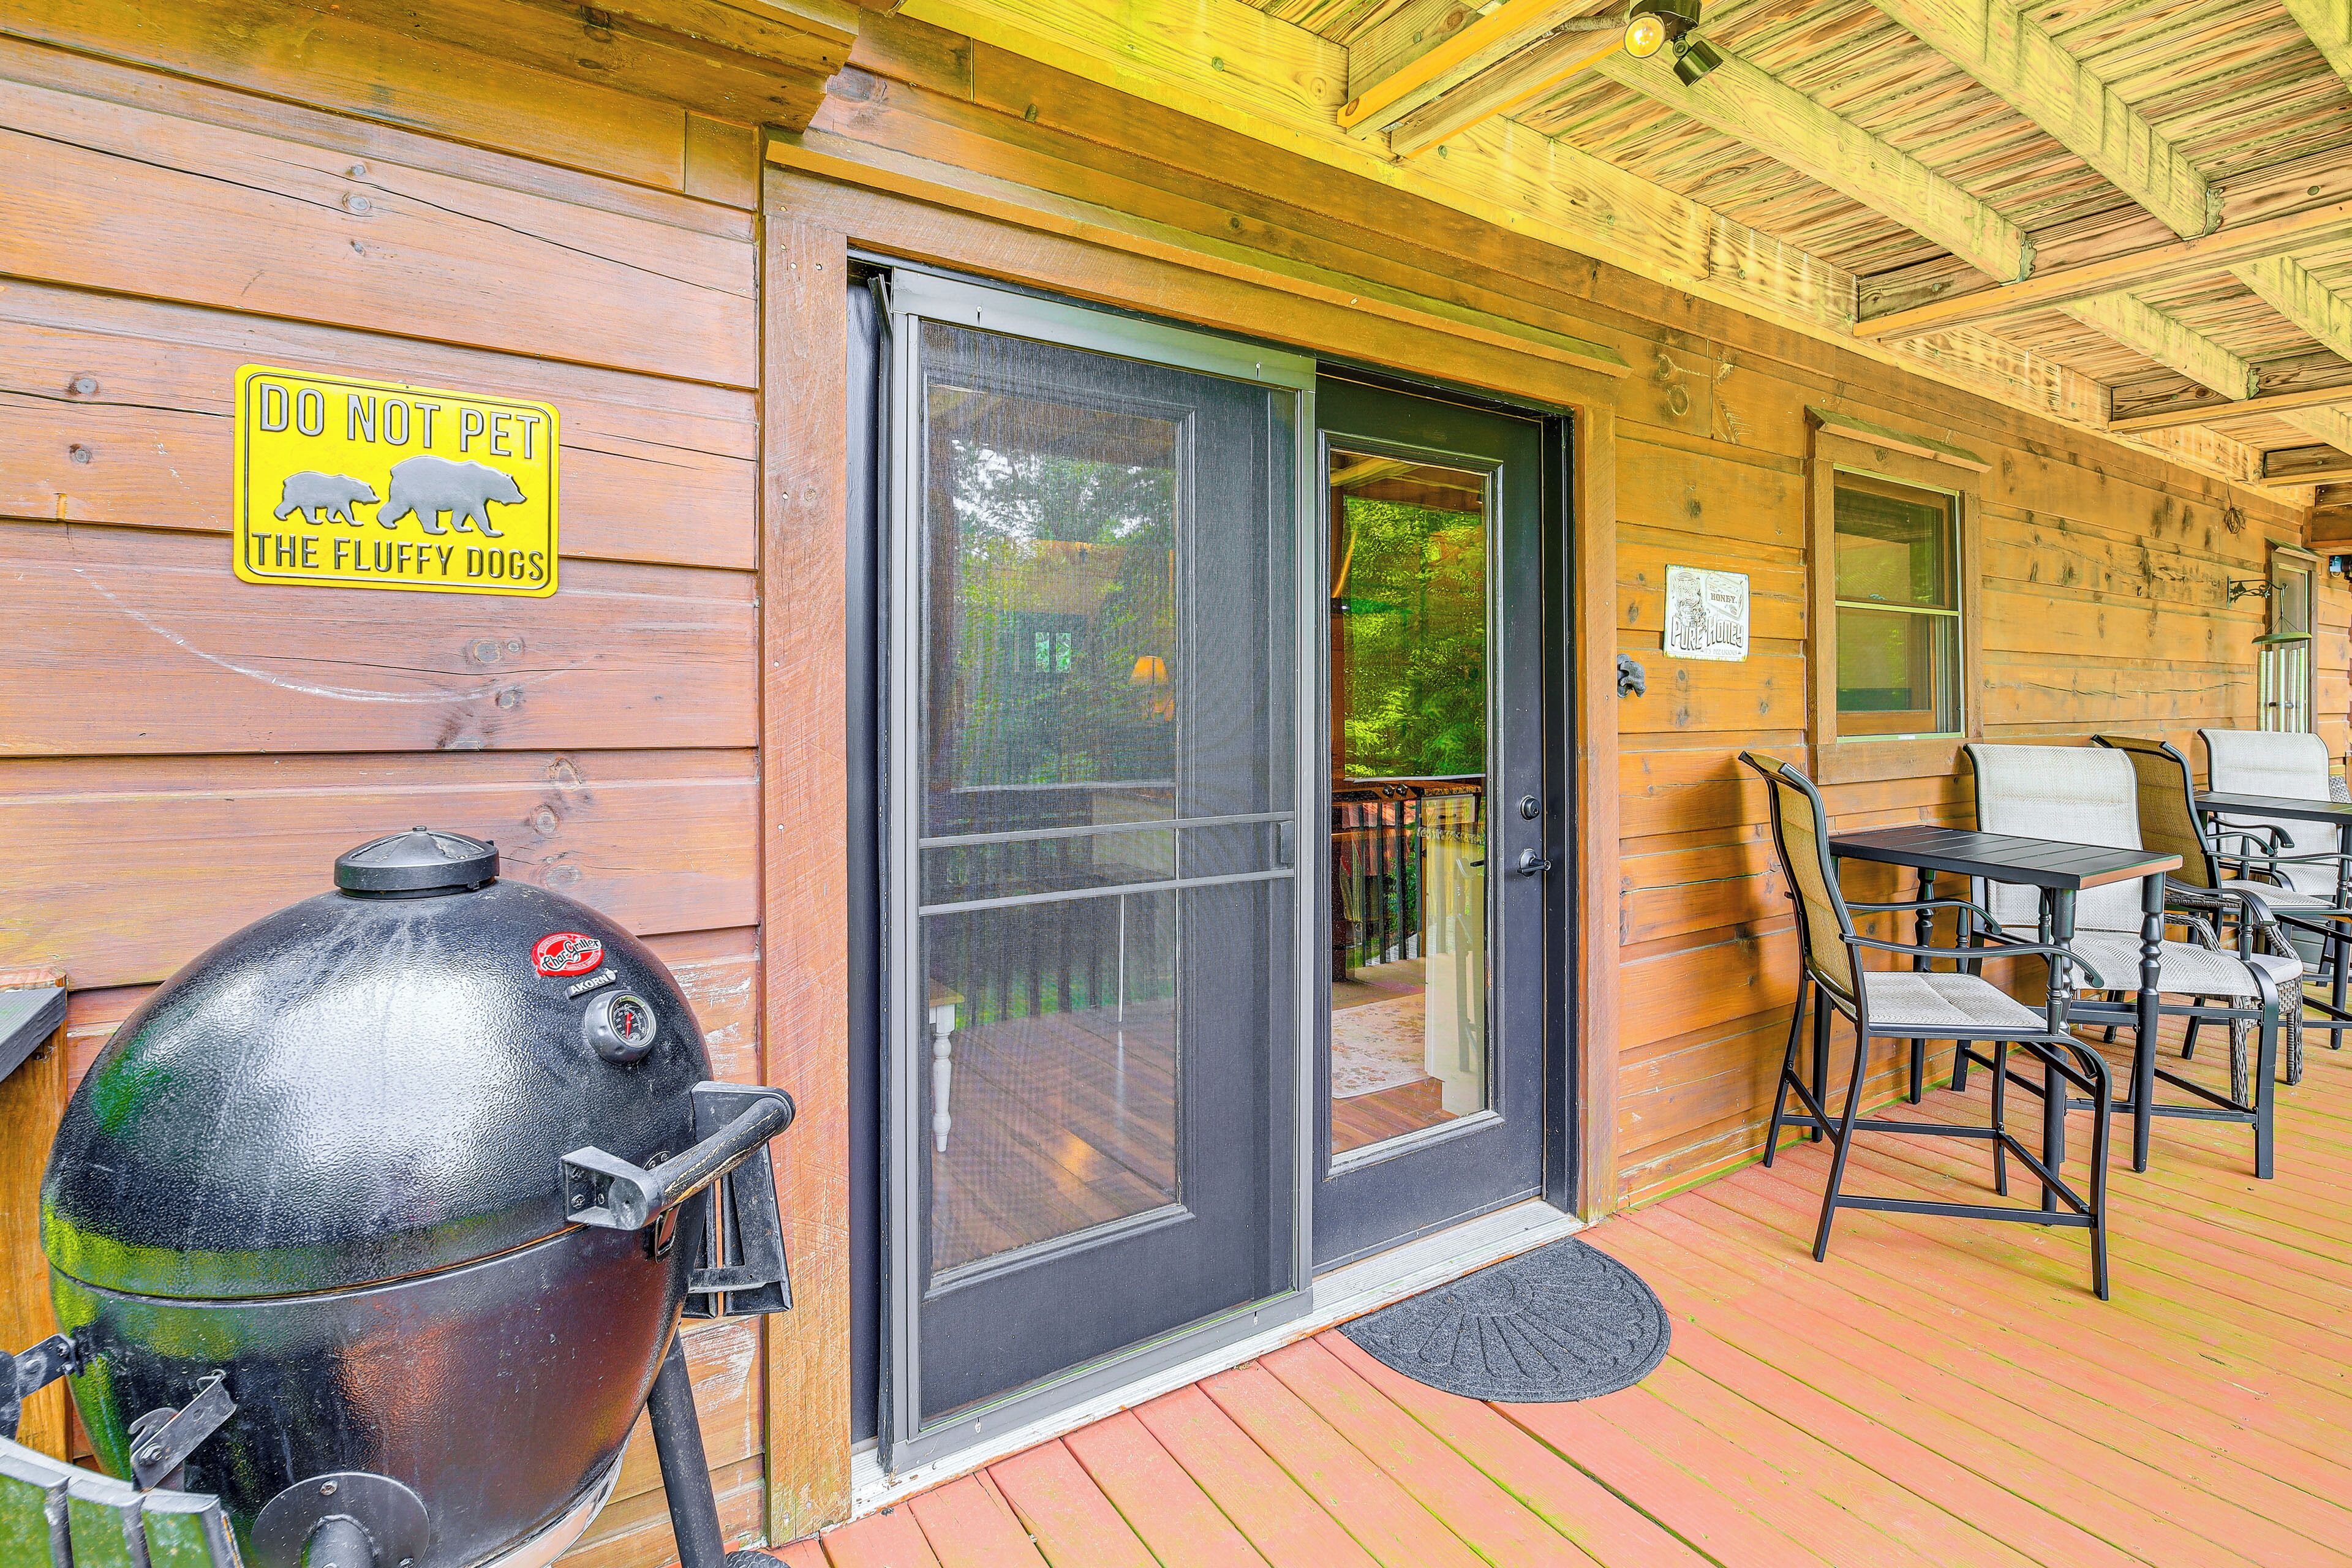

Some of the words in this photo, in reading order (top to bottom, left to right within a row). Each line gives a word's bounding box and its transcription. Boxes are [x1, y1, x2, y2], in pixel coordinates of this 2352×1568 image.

[260, 383, 324, 436] DO
[347, 394, 440, 448] NOT
[460, 408, 540, 459] PET
[252, 532, 319, 568] THE
[334, 537, 454, 575] FLUFFY
[467, 546, 544, 581] DOGS
[1711, 593, 1736, 603] HONEY
[1671, 616, 1703, 650] PURE
[570, 974, 609, 995] AKORN
